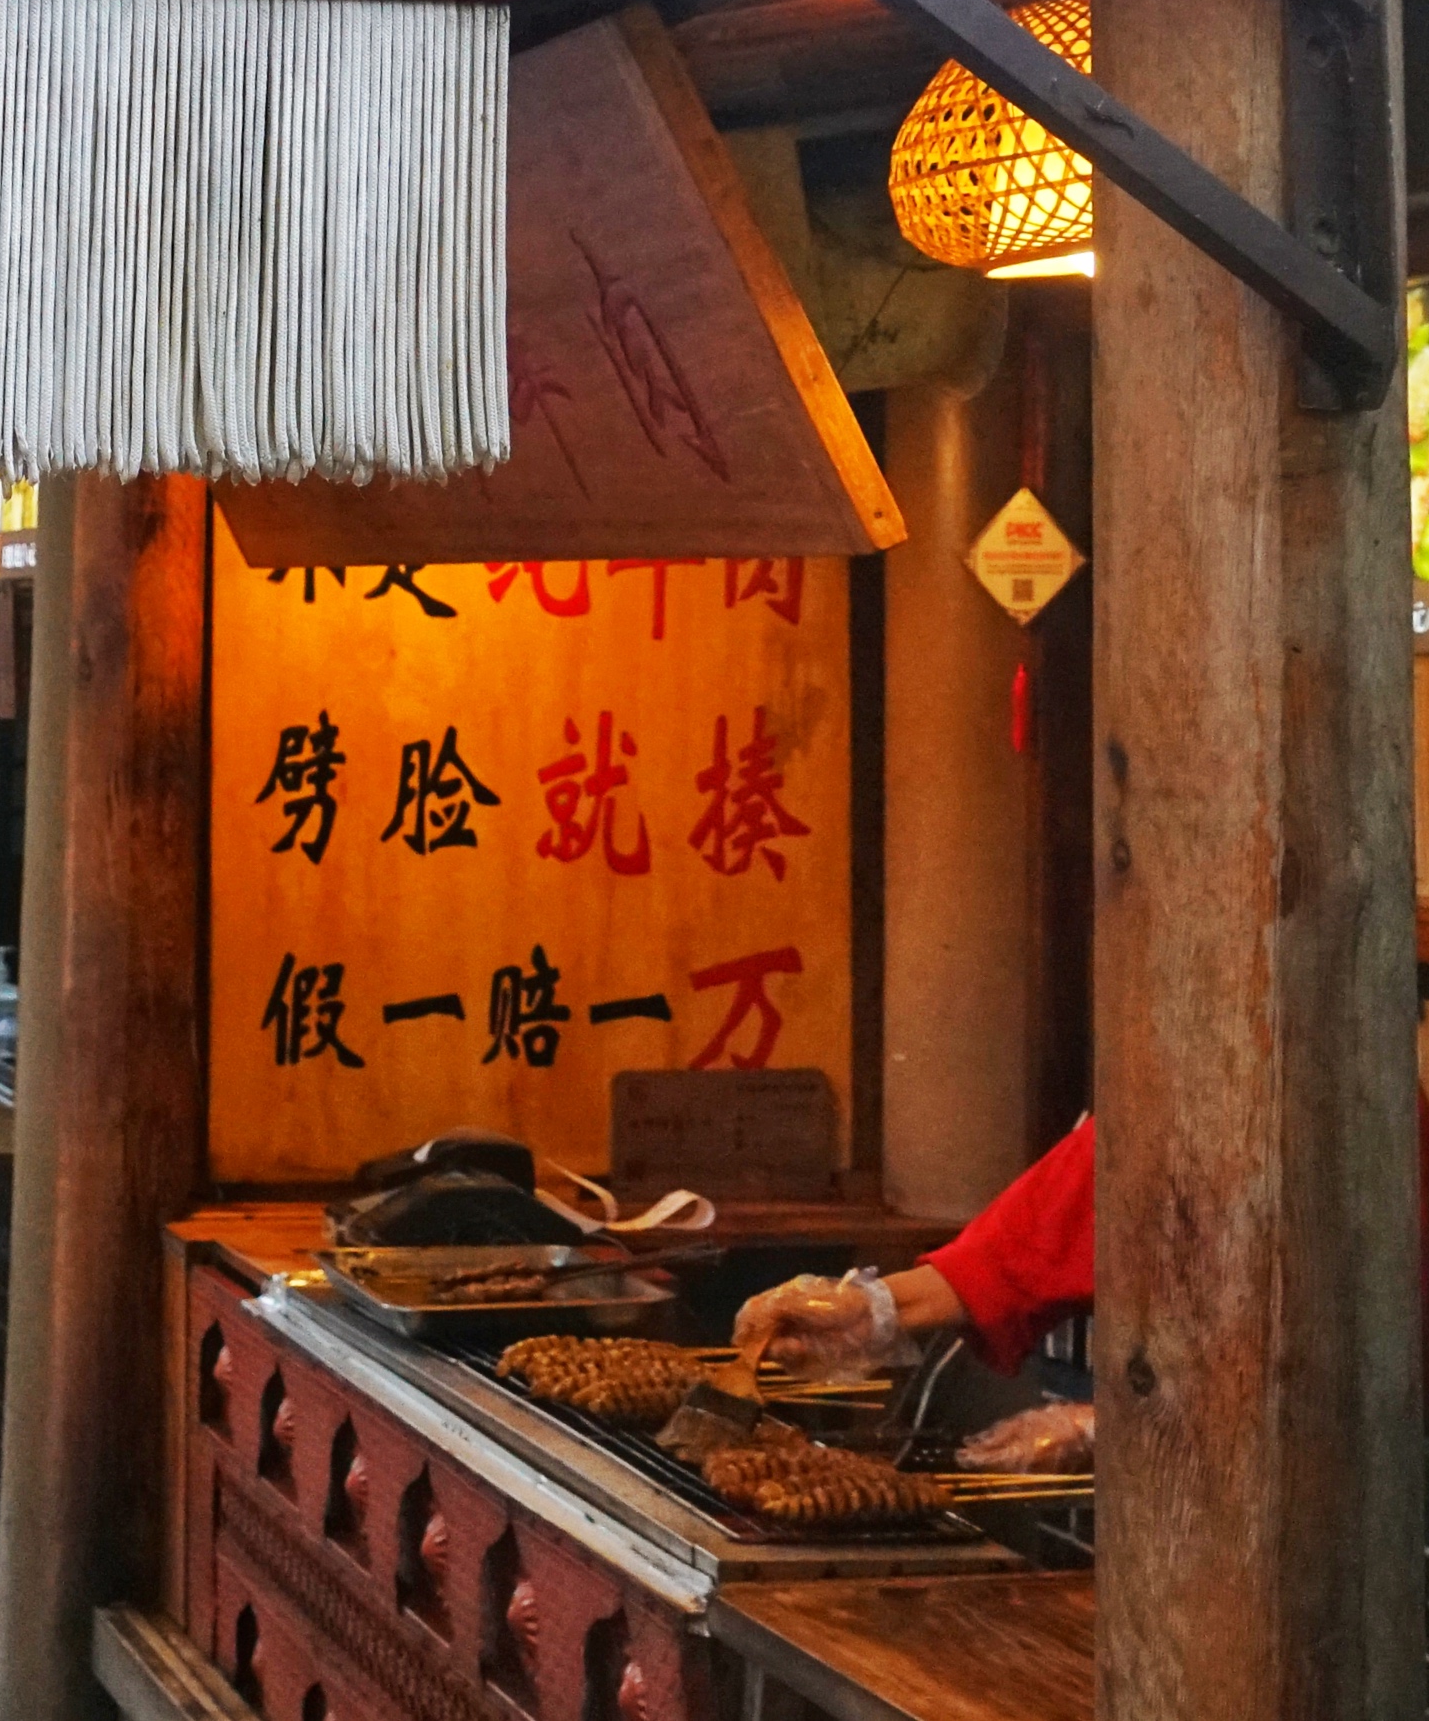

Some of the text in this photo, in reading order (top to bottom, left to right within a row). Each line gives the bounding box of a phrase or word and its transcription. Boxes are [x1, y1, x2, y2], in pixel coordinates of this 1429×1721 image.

[254, 706, 813, 883] 劈脸就揍
[261, 944, 805, 1071] 假一赔一万
